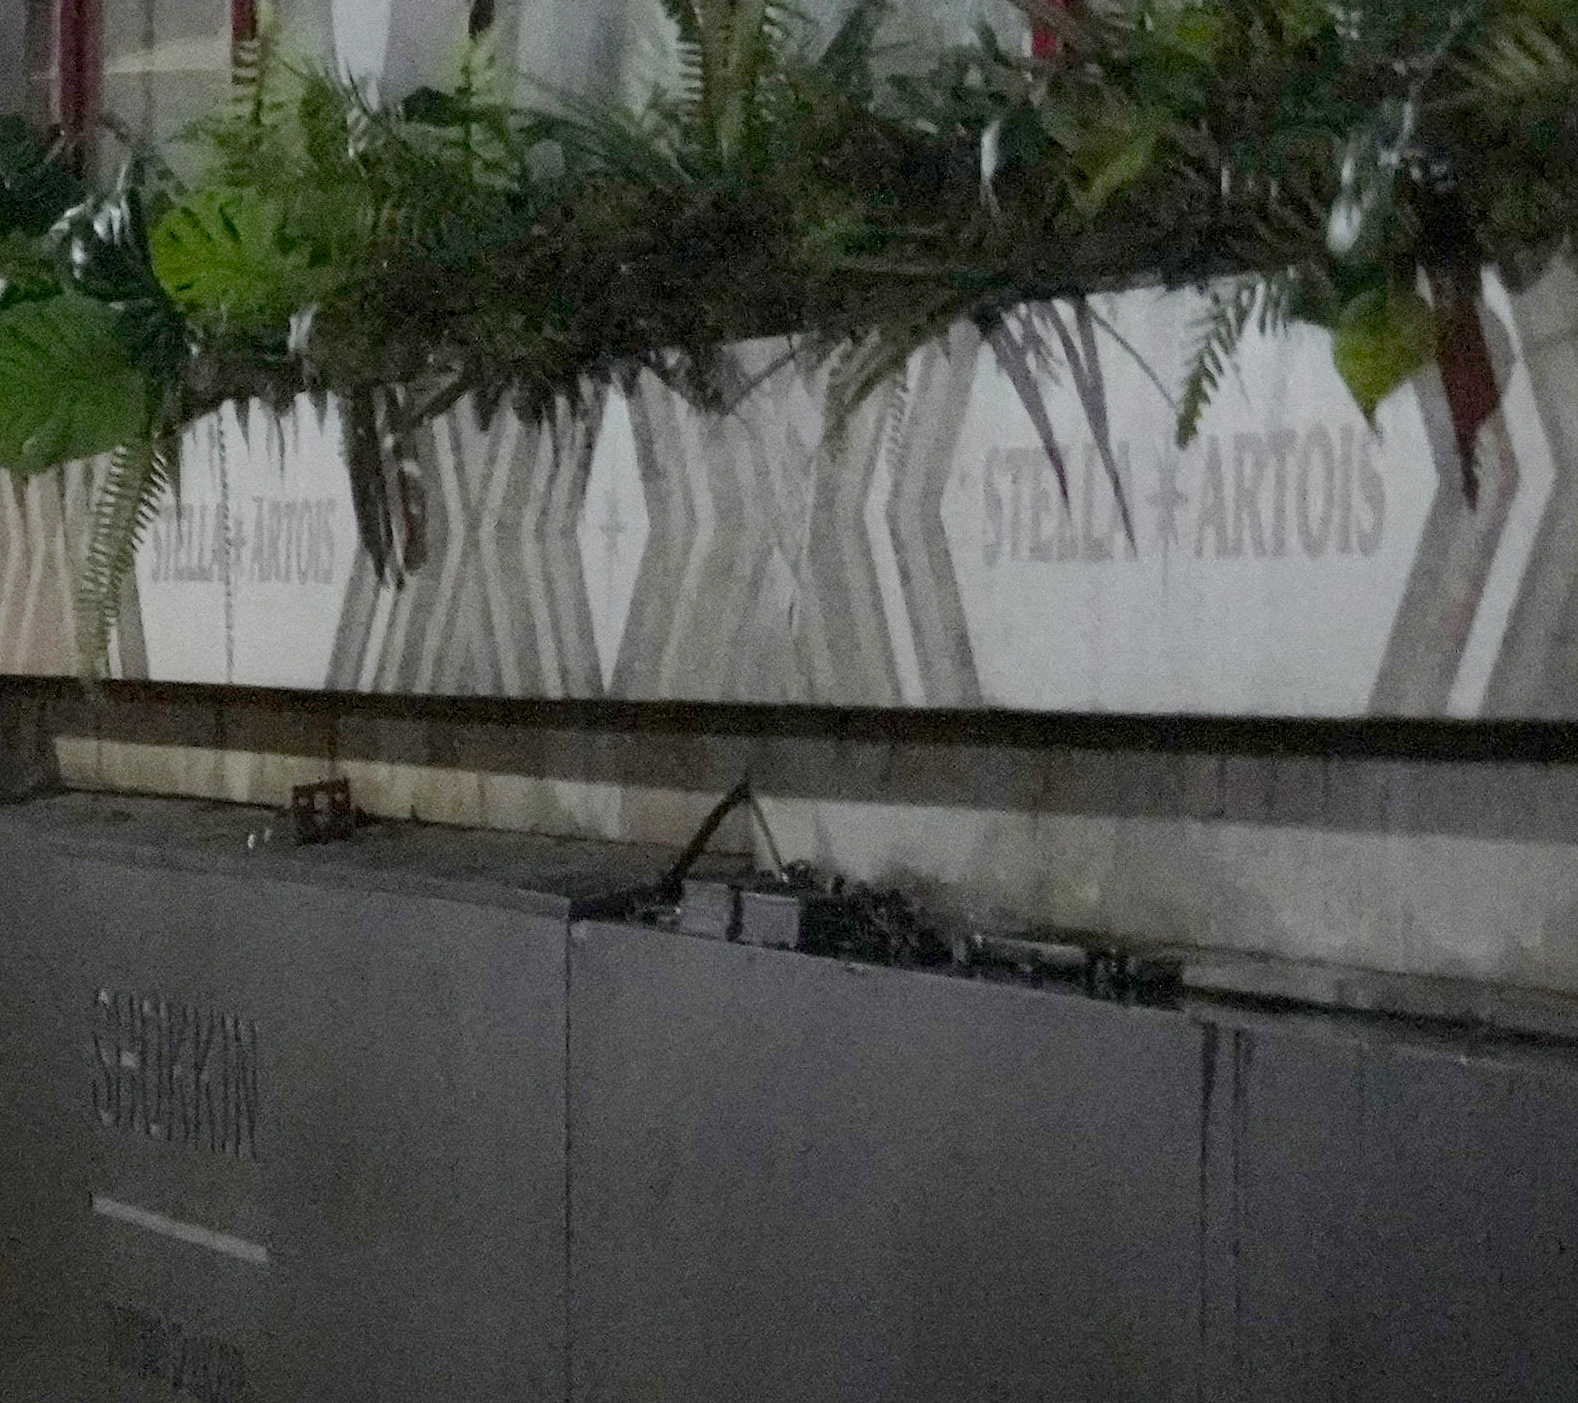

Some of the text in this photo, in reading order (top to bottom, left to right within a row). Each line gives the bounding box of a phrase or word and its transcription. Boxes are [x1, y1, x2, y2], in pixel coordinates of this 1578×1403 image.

[148, 495, 336, 586] STELLA ARTOIS
[1190, 424, 1385, 561] ARTOIS
